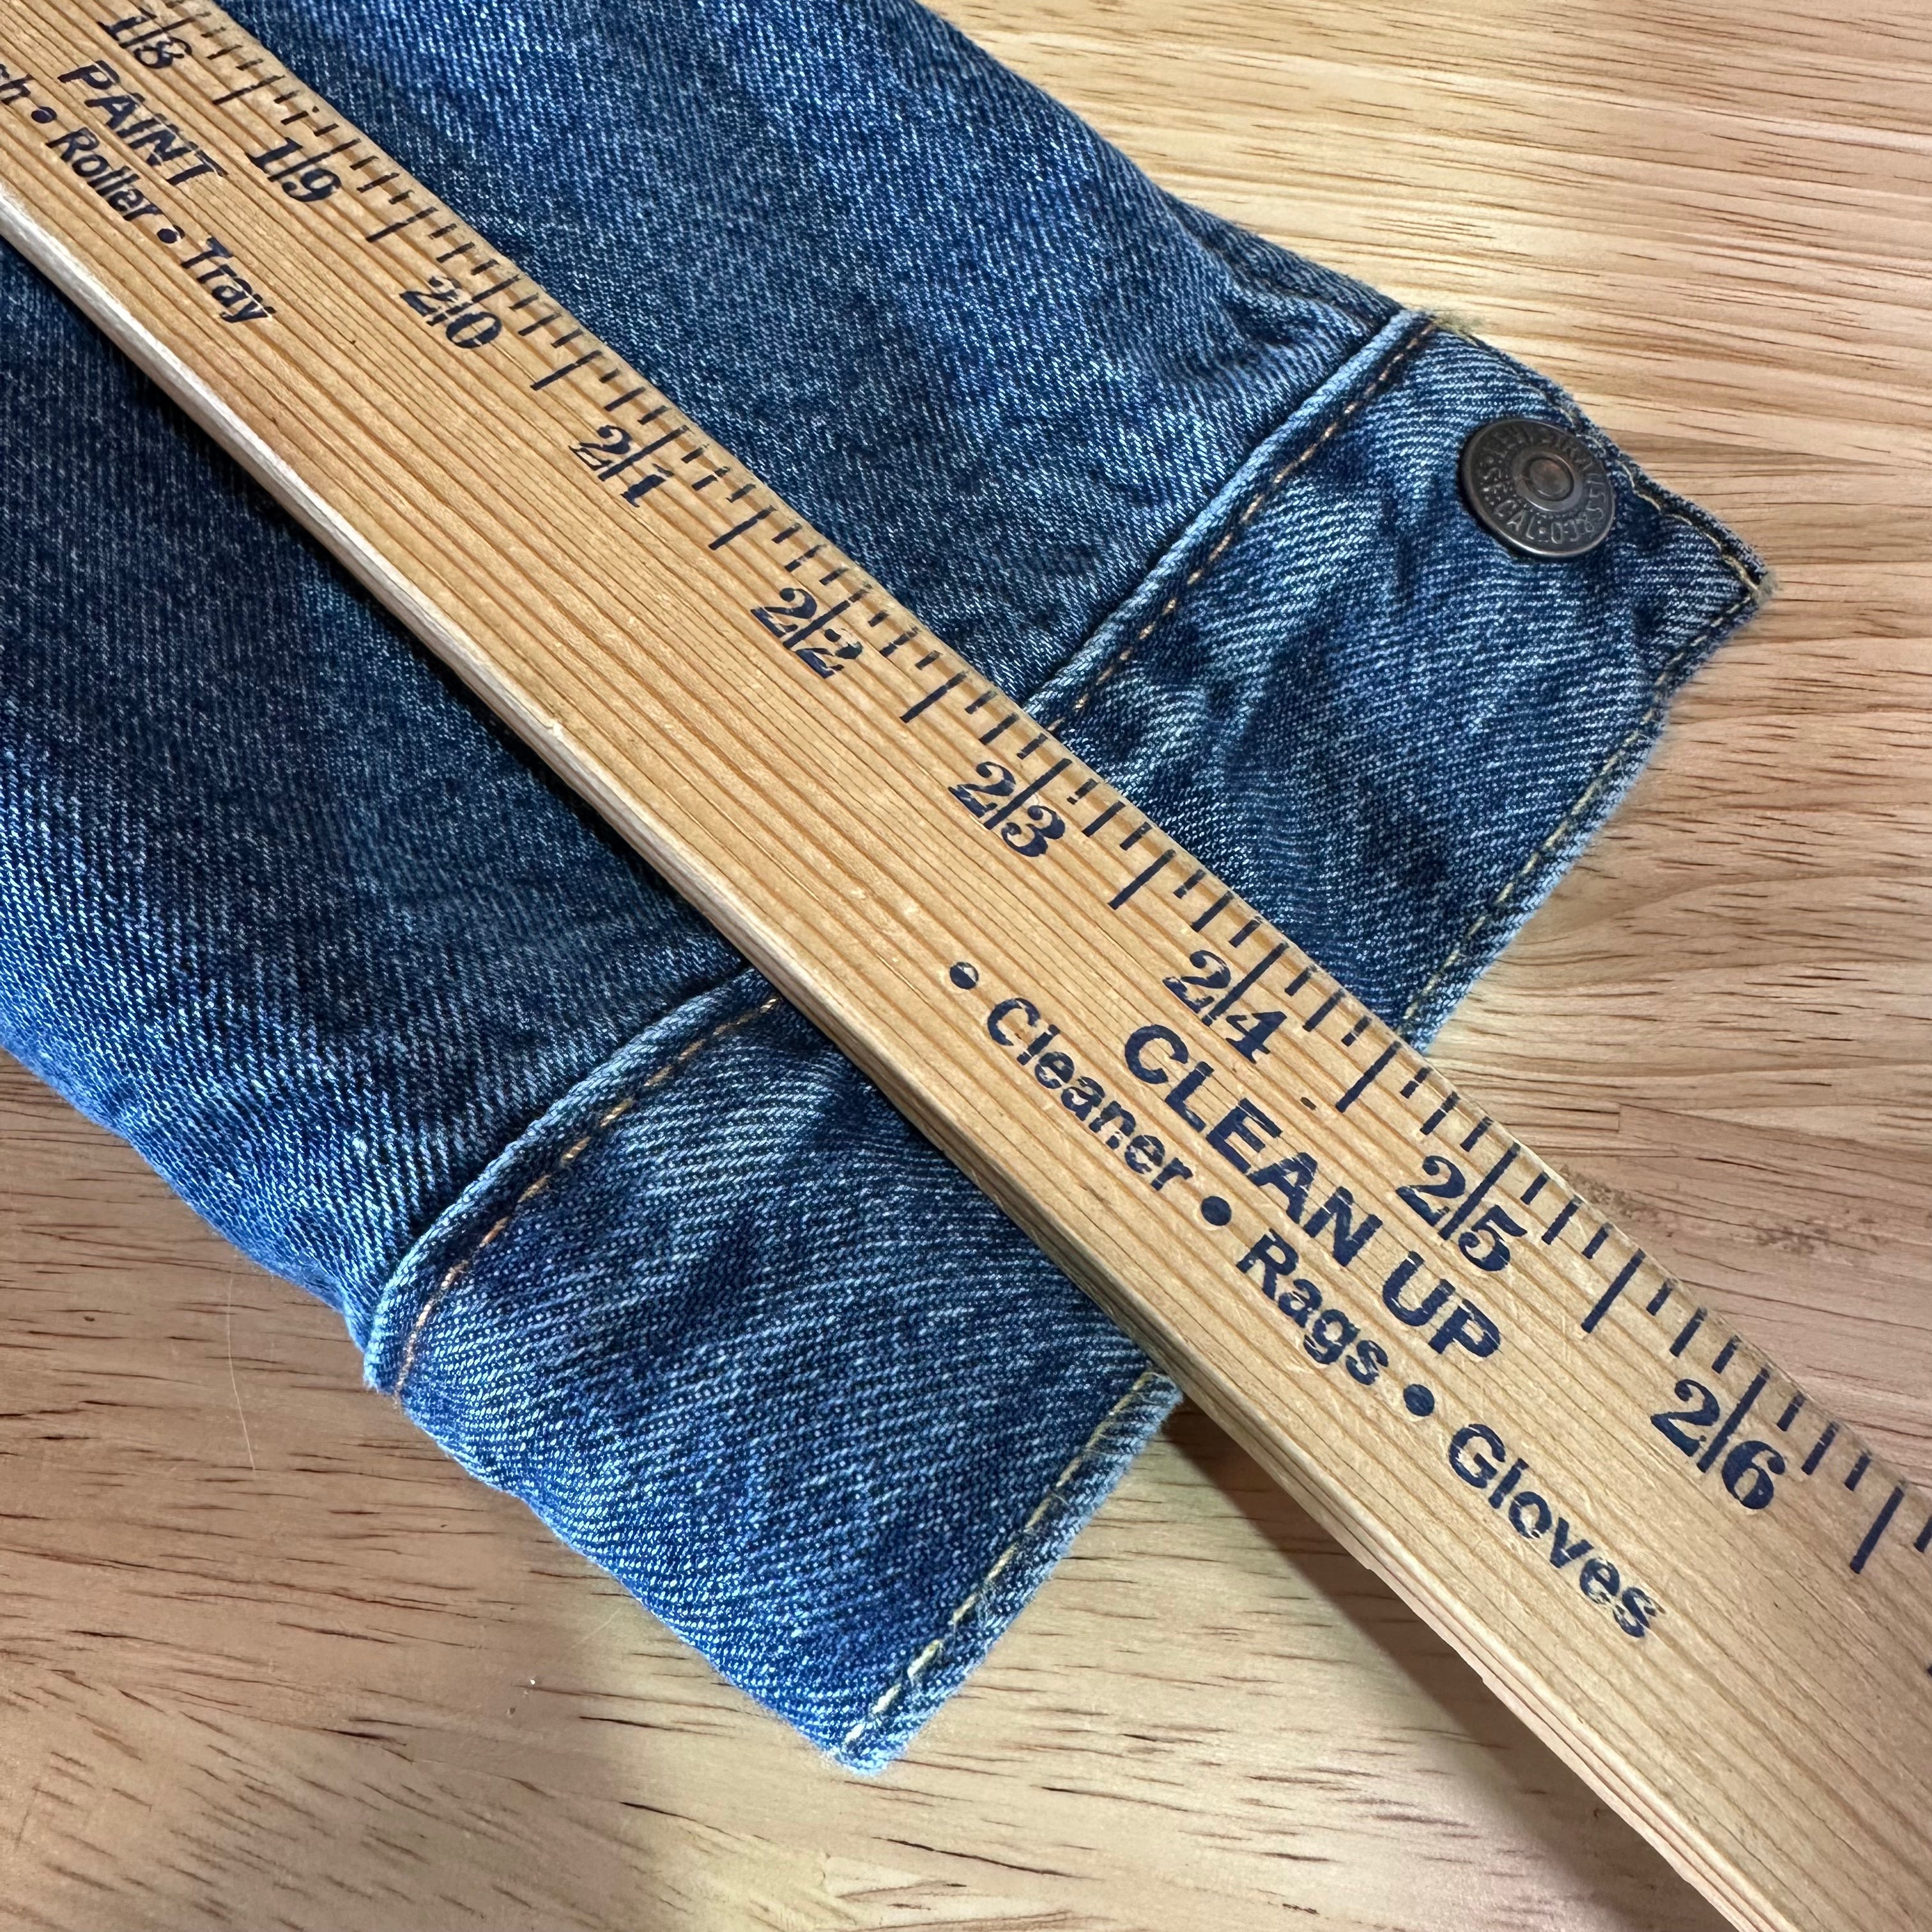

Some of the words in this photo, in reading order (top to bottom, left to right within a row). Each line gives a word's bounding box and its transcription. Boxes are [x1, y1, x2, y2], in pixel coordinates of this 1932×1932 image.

[97, 6, 192, 69] 18
[57, 59, 228, 187] PAINT
[246, 137, 342, 203] 19
[45, 126, 164, 222] Roller
[181, 237, 277, 323] Tray
[399, 275, 503, 349] 20
[569, 424, 674, 508] 21
[750, 587, 863, 678] 22
[948, 761, 1066, 857] 23
[1162, 949, 1287, 1064] 24
[1124, 1023, 1383, 1268] CLEAN
[1382, 1250, 1501, 1358] UP
[1395, 1154, 1528, 1272] 25
[986, 997, 1193, 1192] Cleaner
[1236, 1227, 1390, 1386] Rags
[1447, 1423, 1665, 1639] Gloves
[1650, 1378, 1786, 1510] 26
